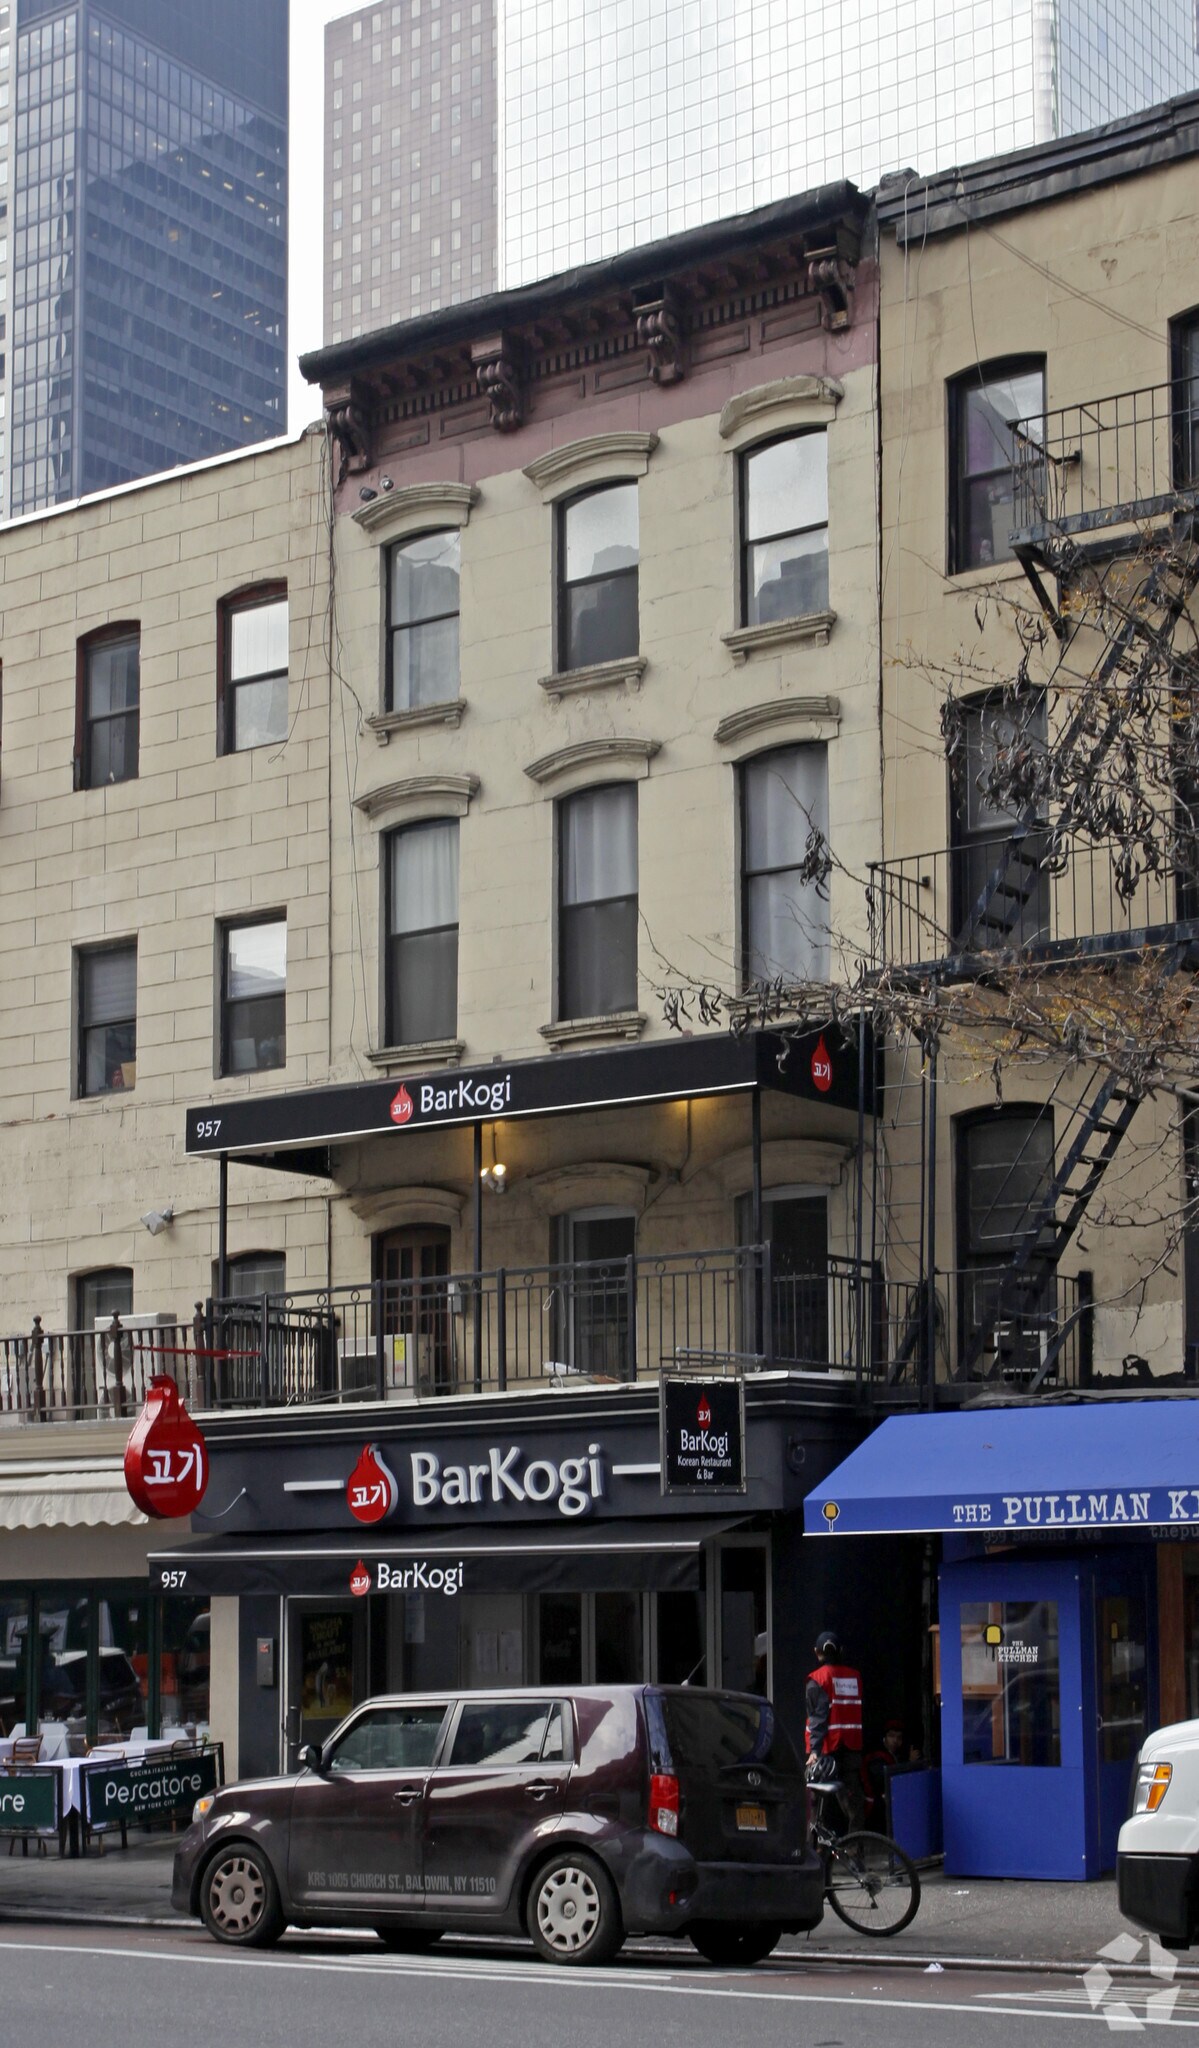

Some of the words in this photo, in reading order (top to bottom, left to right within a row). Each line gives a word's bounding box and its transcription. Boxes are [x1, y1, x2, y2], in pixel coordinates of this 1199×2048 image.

[814, 1062, 830, 1080] 고기
[420, 1075, 511, 1112] BarKogi
[393, 1103, 411, 1115] 고기
[196, 1120, 222, 1138] 957
[680, 1429, 728, 1458] BarKogi
[143, 1443, 203, 1491] 고기
[677, 1455, 699, 1466] Korean
[701, 1456, 732, 1467] Restaurant
[410, 1443, 604, 1516] BarKogi
[696, 1468, 702, 1479] &
[703, 1469, 714, 1479] Bar
[351, 1480, 387, 1507] 고기
[953, 1504, 991, 1522] THE
[1002, 1493, 1151, 1524] PULLMAN
[983, 1529, 1007, 1544] 959
[1012, 1528, 1066, 1542] Second
[1075, 1527, 1102, 1541] Ave
[161, 1571, 187, 1588] 957
[352, 1575, 369, 1588] 고기
[377, 1562, 463, 1595] BarKogi
[998, 1646, 1039, 1654] PULLMAN
[998, 1654, 1038, 1662] KITCHEN
[105, 1774, 202, 1806] Pescatore
[0, 1794, 25, 1812] re
[308, 1872, 326, 1886] KRS
[328, 1873, 348, 1888] 1005
[350, 1873, 386, 1888] CHURCH
[405, 1874, 452, 1893] BALDWIN,
[454, 1875, 467, 1892] NY
[469, 1876, 496, 1893] 11510
